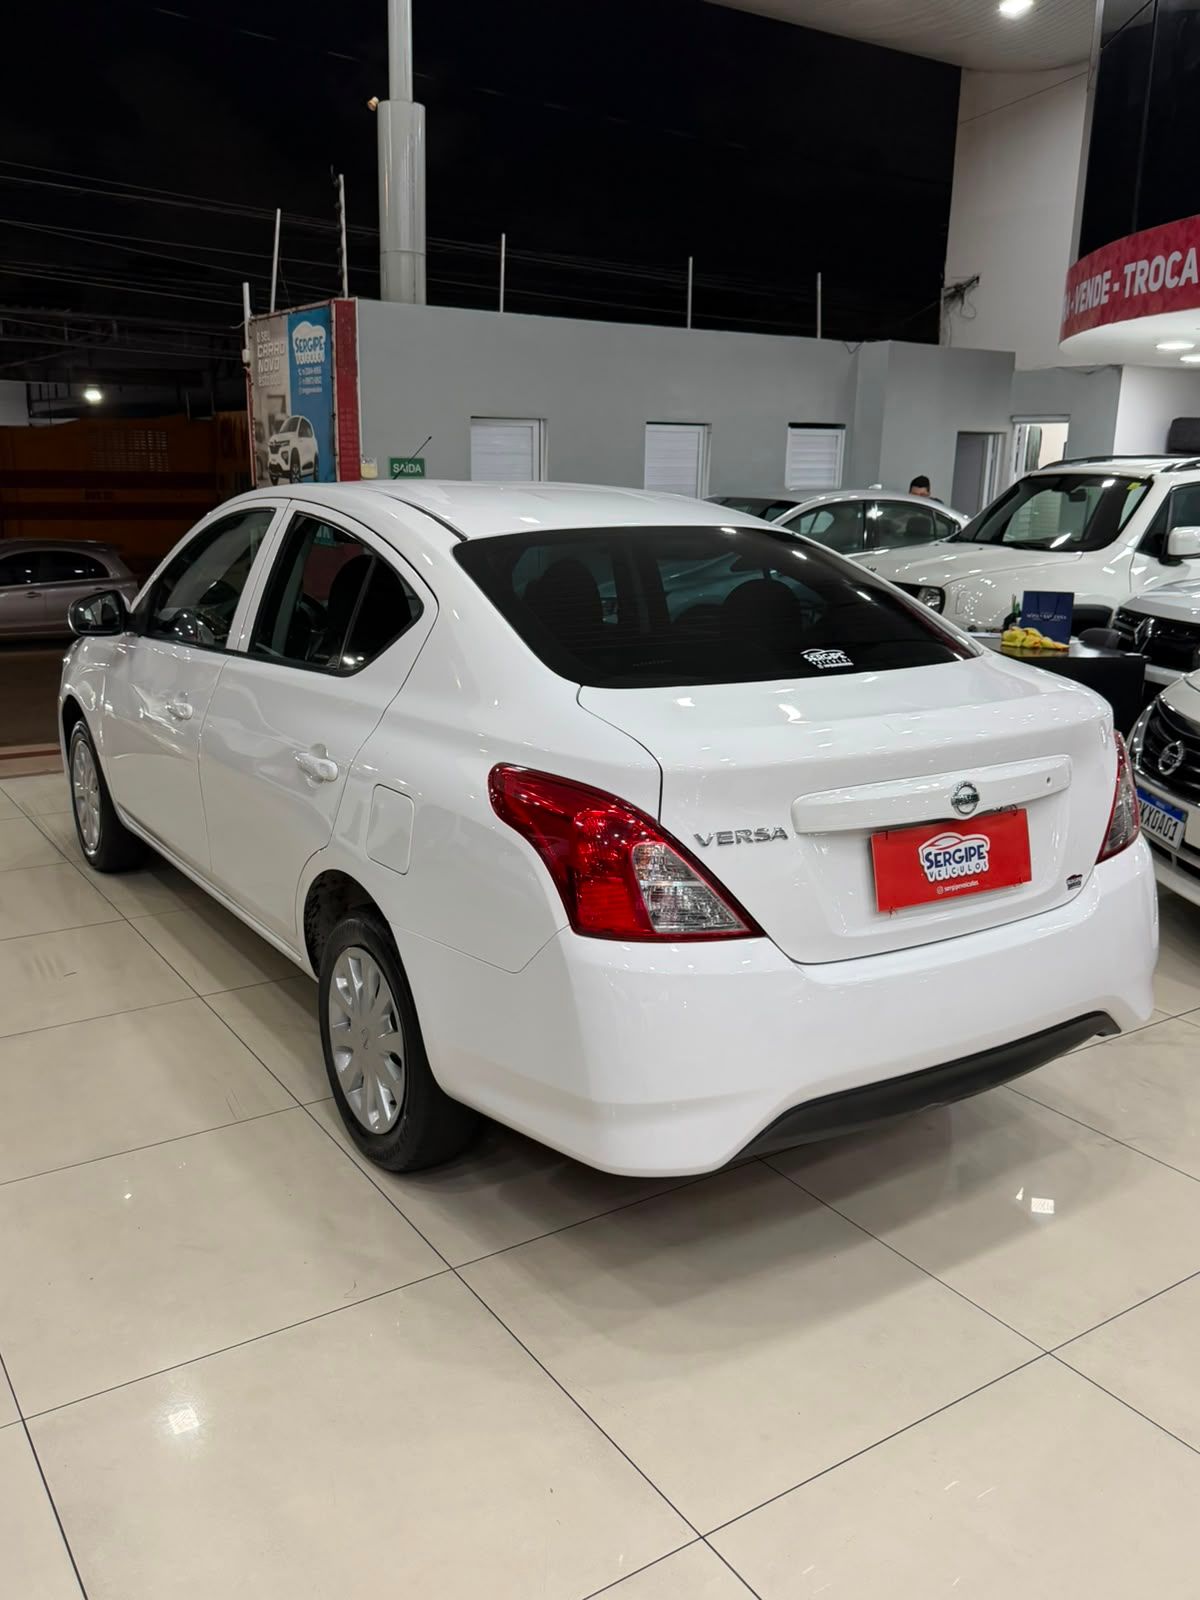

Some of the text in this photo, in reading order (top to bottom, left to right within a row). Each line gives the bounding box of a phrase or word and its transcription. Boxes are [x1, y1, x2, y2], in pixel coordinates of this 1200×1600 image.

[1074, 270, 1112, 315] VENDE
[1123, 247, 1199, 298] TROCA
[257, 342, 285, 358] CARRO
[294, 336, 324, 353] SERGIPE
[258, 358, 280, 373] NOVO
[393, 462, 422, 474] SAÍDA
[693, 826, 788, 847] VERSA
[924, 844, 986, 870] SERGIPE
[929, 861, 988, 880] VEÍCULOS
